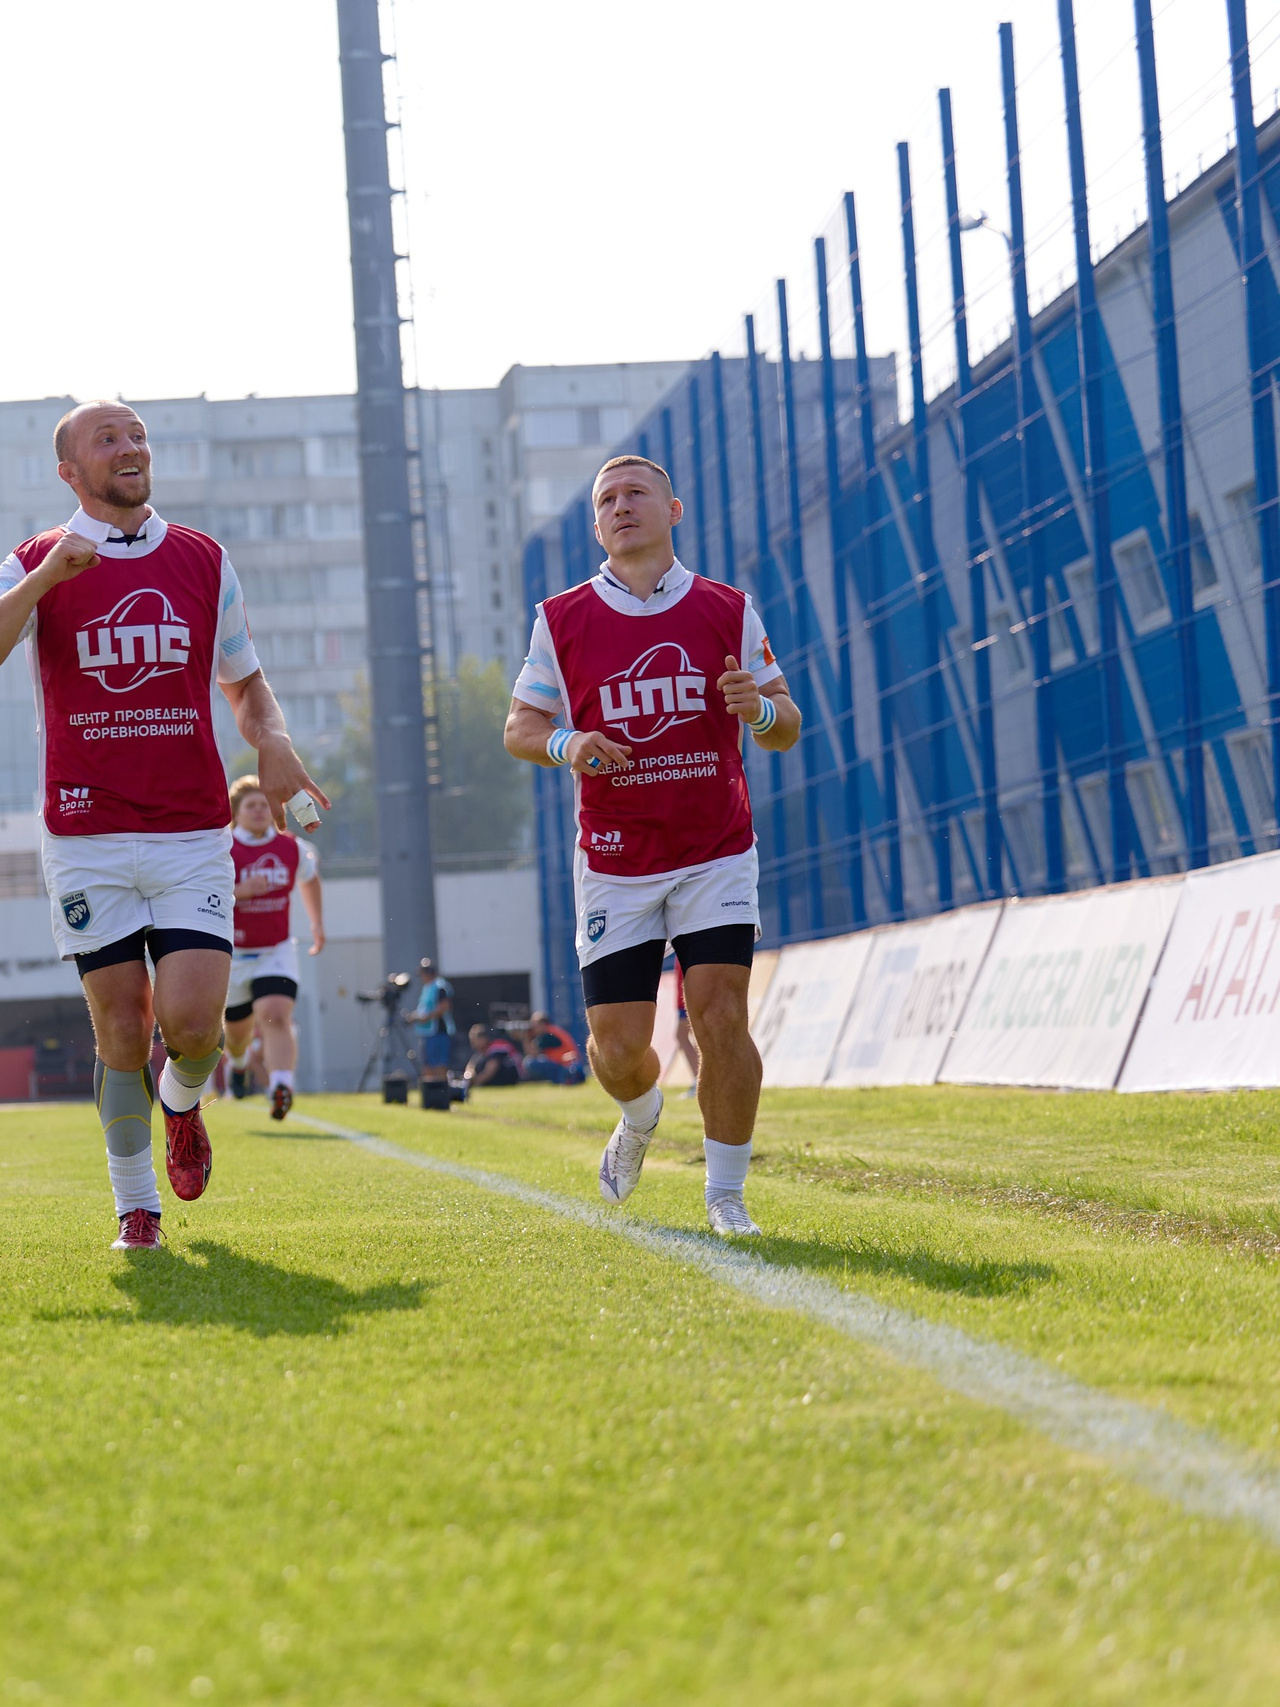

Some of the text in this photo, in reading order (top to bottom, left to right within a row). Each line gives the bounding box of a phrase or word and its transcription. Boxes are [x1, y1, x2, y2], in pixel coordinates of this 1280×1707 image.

[76, 624, 191, 669] ЦПС
[599, 676, 706, 721] ЦПС
[69, 711, 109, 726] ЦЕНТР
[83, 721, 194, 740] СОРЕВНОВАНИЙ
[611, 763, 717, 787] СОРЕВНОВАНИЙ
[59, 800, 94, 812] SPORT
